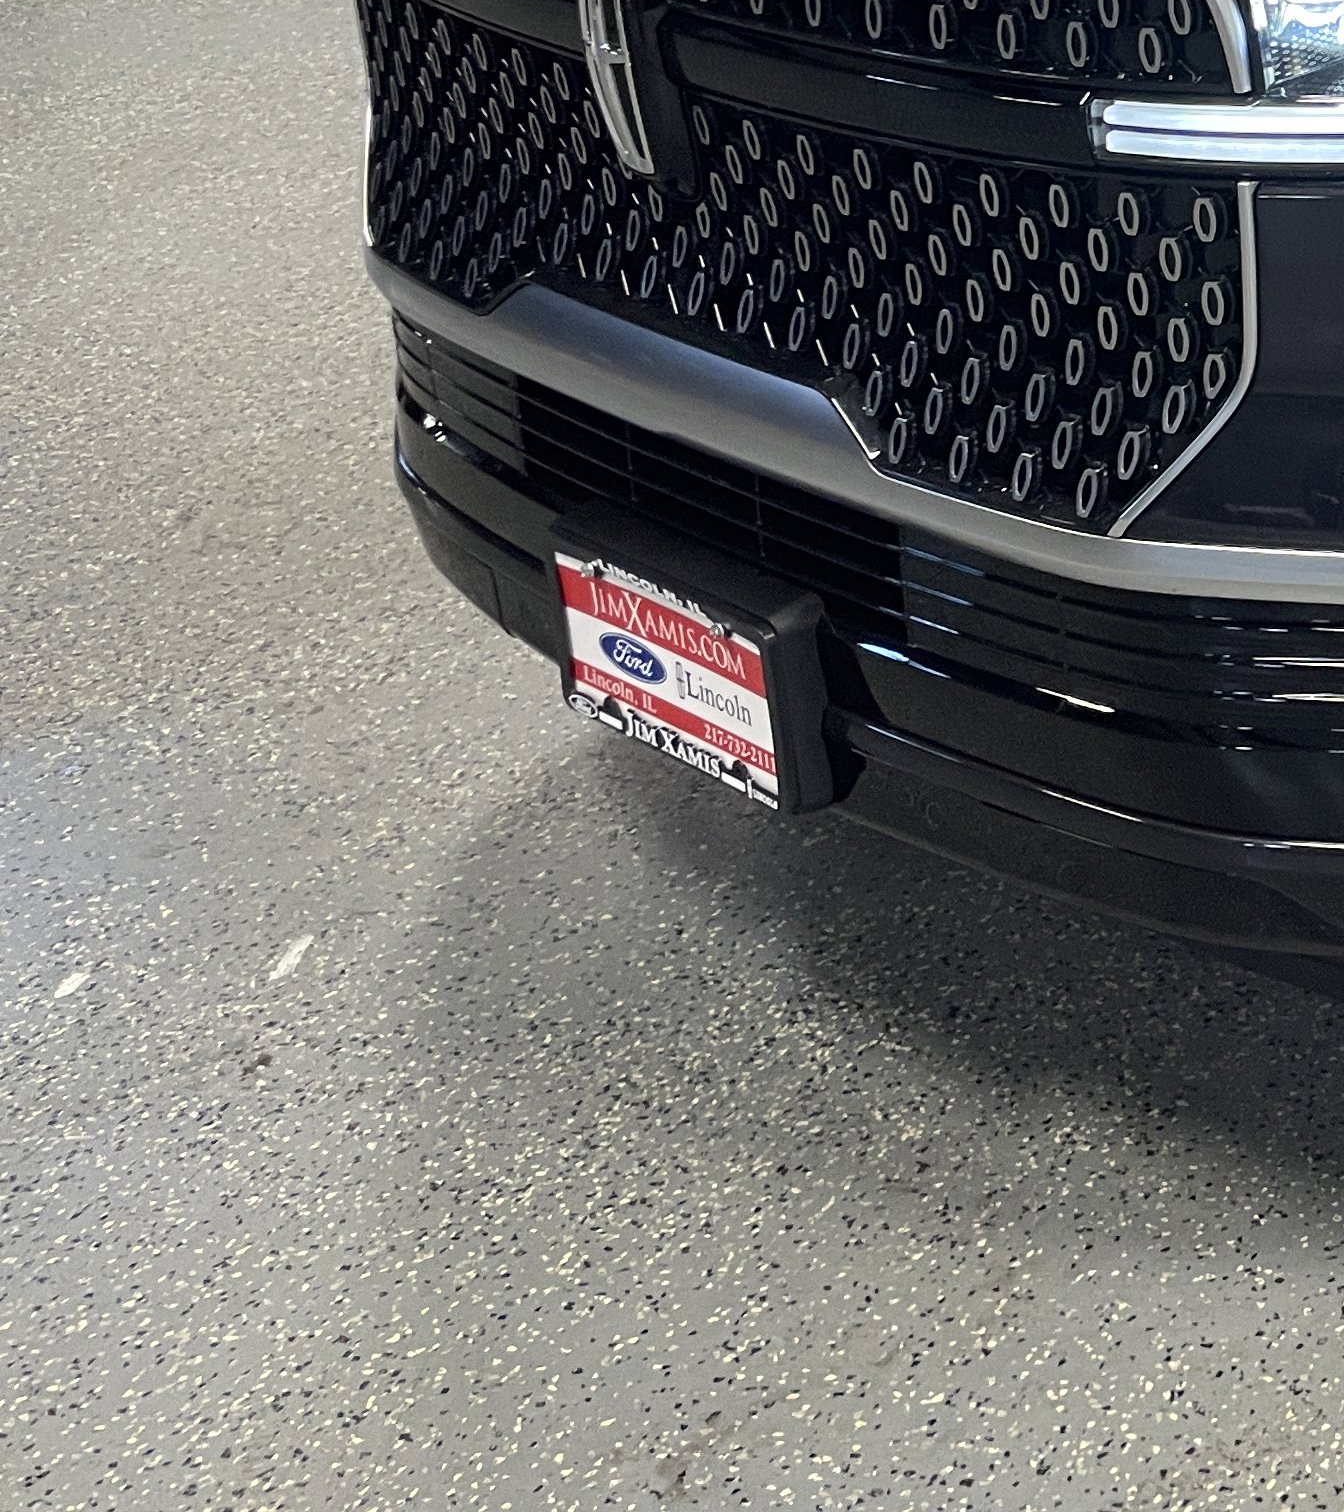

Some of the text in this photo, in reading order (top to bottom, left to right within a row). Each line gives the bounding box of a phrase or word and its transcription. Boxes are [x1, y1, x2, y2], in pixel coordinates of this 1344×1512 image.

[613, 638, 655, 677] Ford
[643, 693, 657, 713] IL
[684, 671, 752, 727] Lincoln
[704, 723, 776, 773] 217-732-2111
